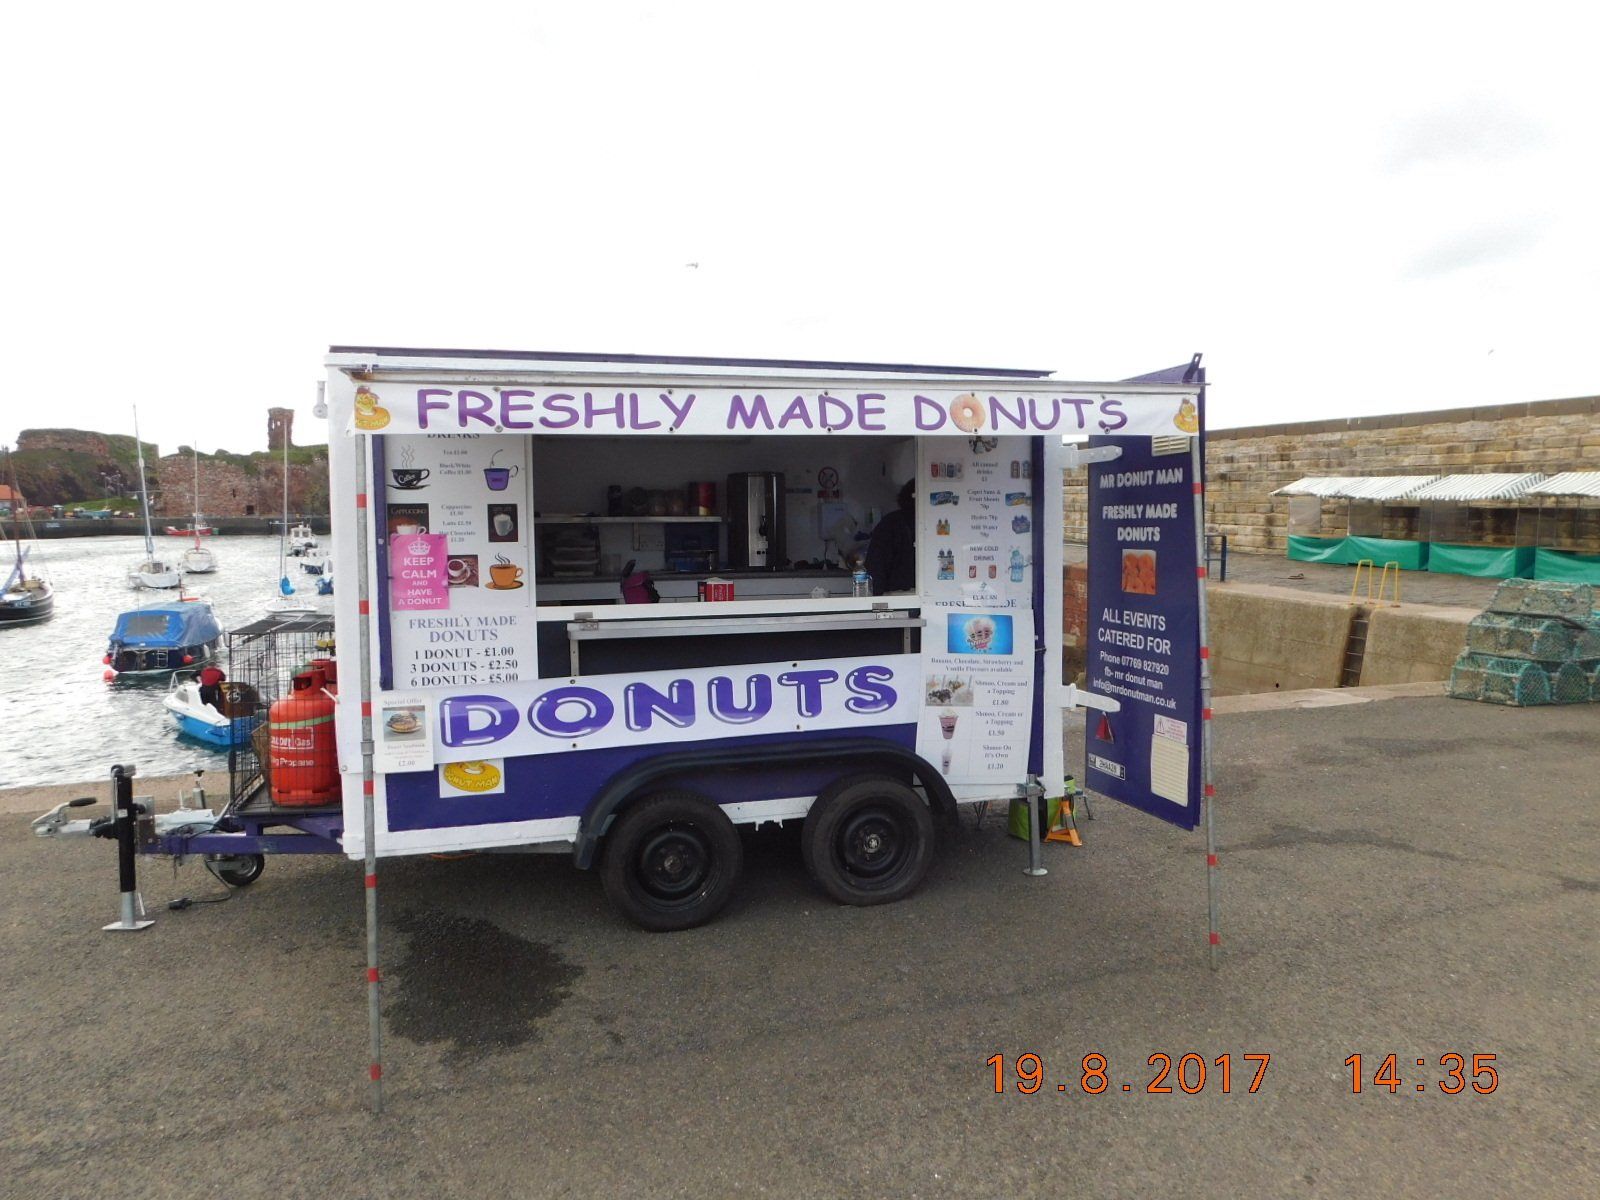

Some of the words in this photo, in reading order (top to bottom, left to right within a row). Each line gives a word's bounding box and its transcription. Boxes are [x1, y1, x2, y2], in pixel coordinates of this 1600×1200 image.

[417, 389, 696, 430] FRESHLY
[726, 393, 886, 431] MADE
[913, 394, 1128, 432] DONUTS
[1100, 473, 1115, 489] MR
[1117, 470, 1154, 488] DONUT
[1156, 467, 1183, 485] MAN
[1102, 504, 1144, 520] FRESHLY
[1145, 503, 1178, 519] MADE
[1117, 526, 1161, 542] DONUTS
[403, 557, 434, 566] KEEP
[401, 570, 437, 579] CALM
[407, 588, 433, 596] HAVE
[407, 598, 442, 606] DONUT
[409, 616, 472, 629] FRESHLY
[477, 615, 517, 627] MADE
[1102, 607, 1121, 625] ALL
[1123, 611, 1166, 631] EVENTS
[429, 629, 498, 643] DONUTS
[1098, 627, 1144, 650] CATERED
[1147, 636, 1171, 656] FOR
[414, 650, 420, 660] 1
[424, 648, 473, 660] DONUT
[484, 646, 514, 657] £1.00
[410, 663, 417, 674] 3
[421, 661, 477, 673] DONUTS
[488, 659, 518, 670] £2.50
[1100, 650, 1120, 665] Phone
[1143, 660, 1170, 676] 827920
[410, 677, 418, 687] 6
[421, 674, 477, 687] DONUTS
[488, 673, 519, 684] £5.00
[1114, 671, 1124, 680] mr
[1125, 672, 1146, 686] donut
[1146, 678, 1164, 691] man
[439, 665, 898, 748] DONUTS
